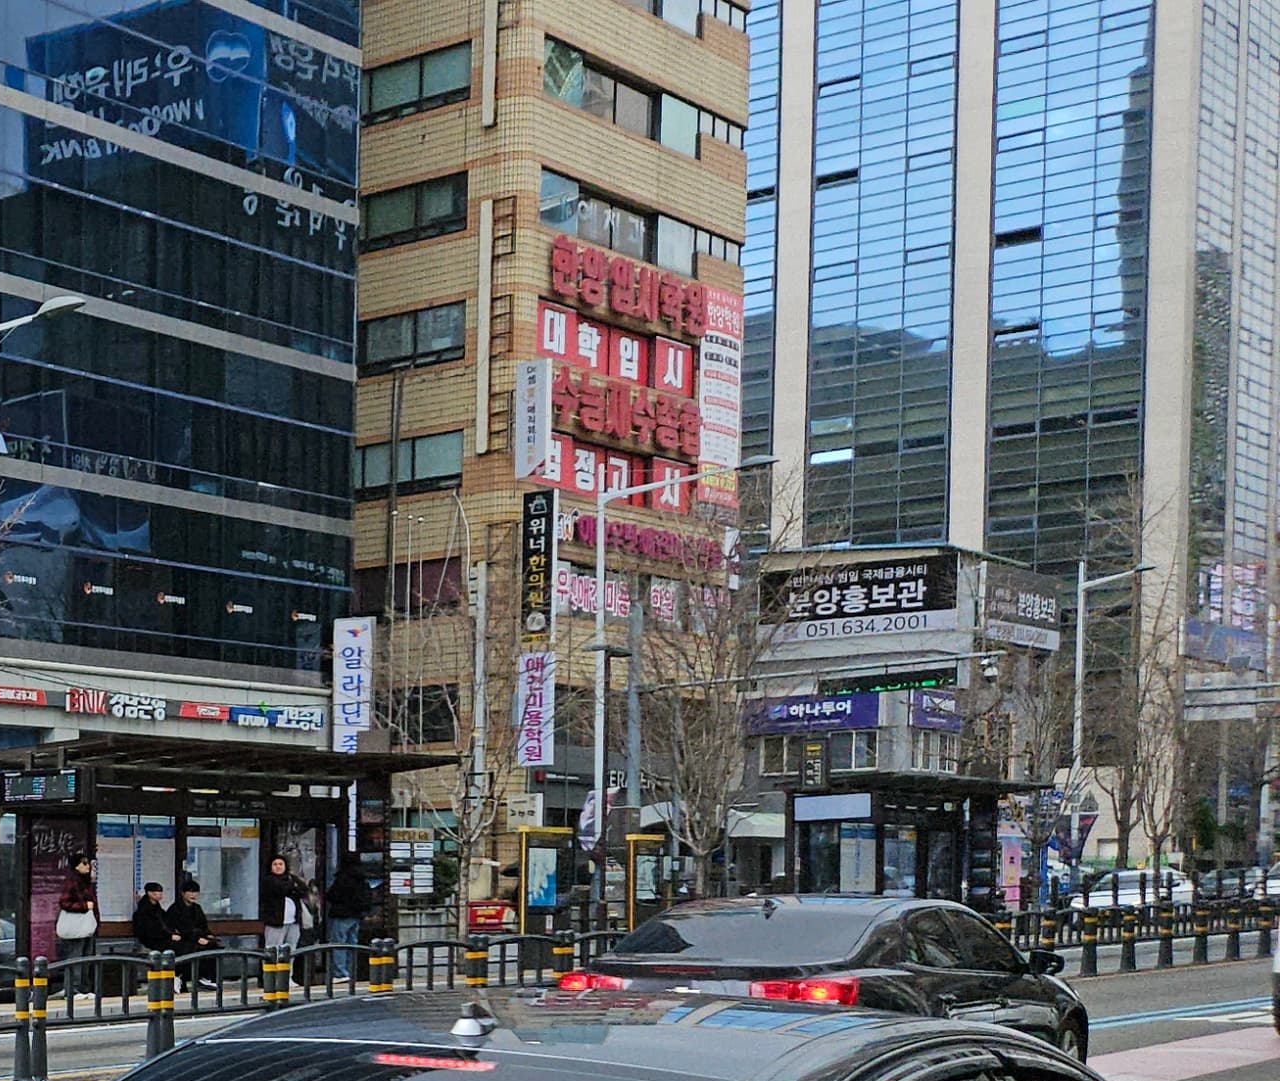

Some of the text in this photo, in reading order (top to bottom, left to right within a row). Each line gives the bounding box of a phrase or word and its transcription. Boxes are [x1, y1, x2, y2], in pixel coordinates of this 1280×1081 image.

[543, 309, 684, 391] 대학입시
[528, 517, 545, 608] 위너한의원
[862, 563, 928, 581] 국제금융시티
[806, 614, 928, 638] 051.634.2001
[341, 646, 365, 727] 알라딘
[65, 688, 107, 715] BNK
[109, 692, 167, 720] 경남은행
[790, 700, 853, 719] 하나투어
[276, 706, 323, 731] 교보증권
